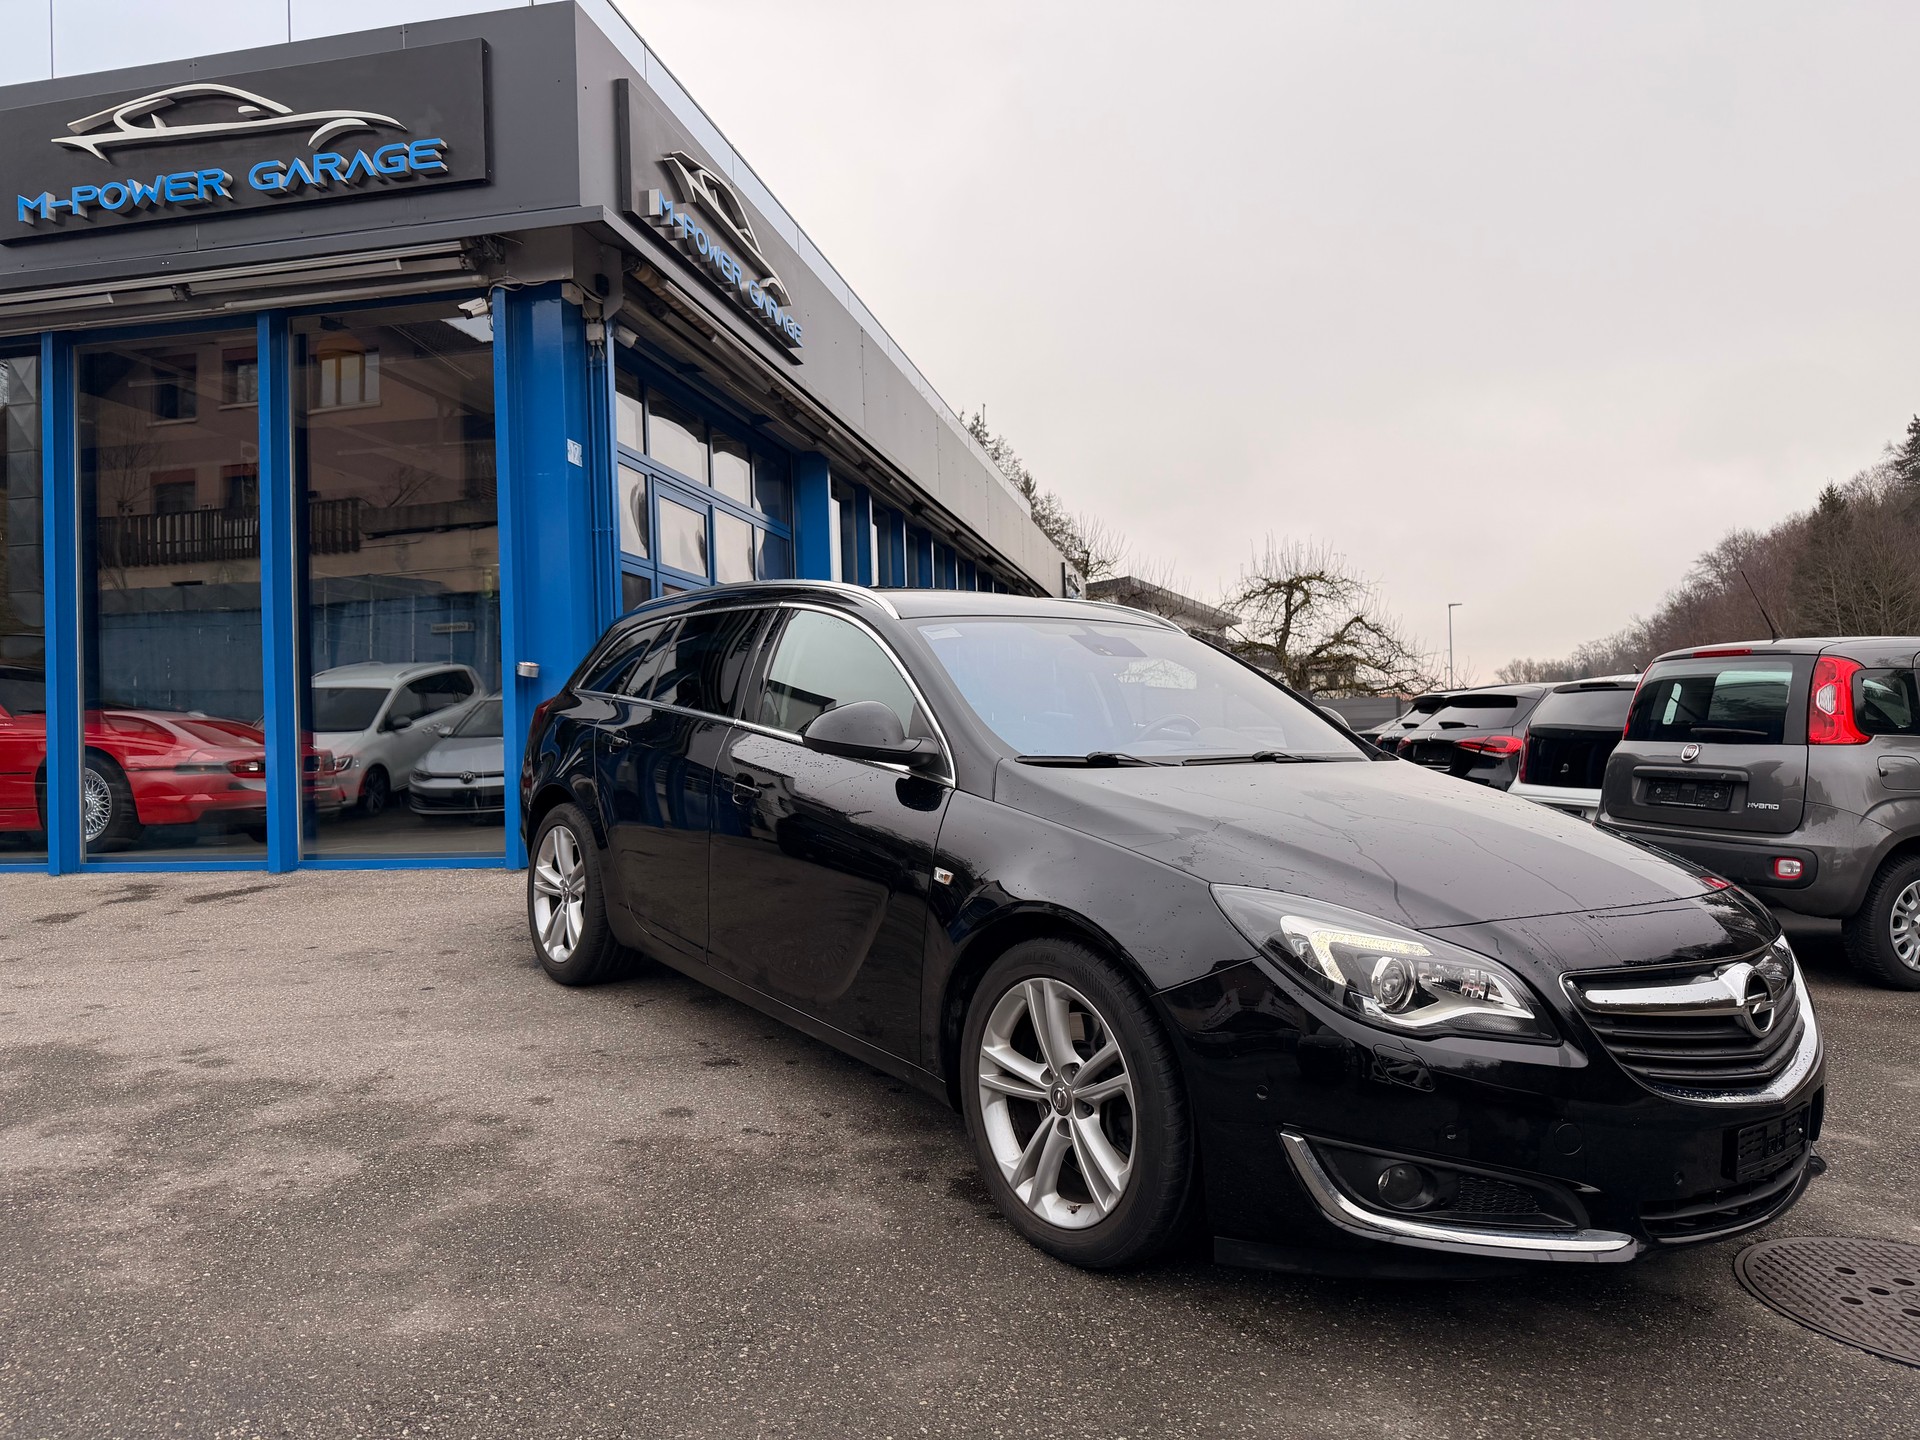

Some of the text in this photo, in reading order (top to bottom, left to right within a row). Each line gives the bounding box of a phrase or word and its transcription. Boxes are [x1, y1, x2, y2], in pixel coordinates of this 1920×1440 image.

[17, 137, 444, 223] M-POWER GARAGE
[658, 190, 803, 348] M-POWER GARAGE
